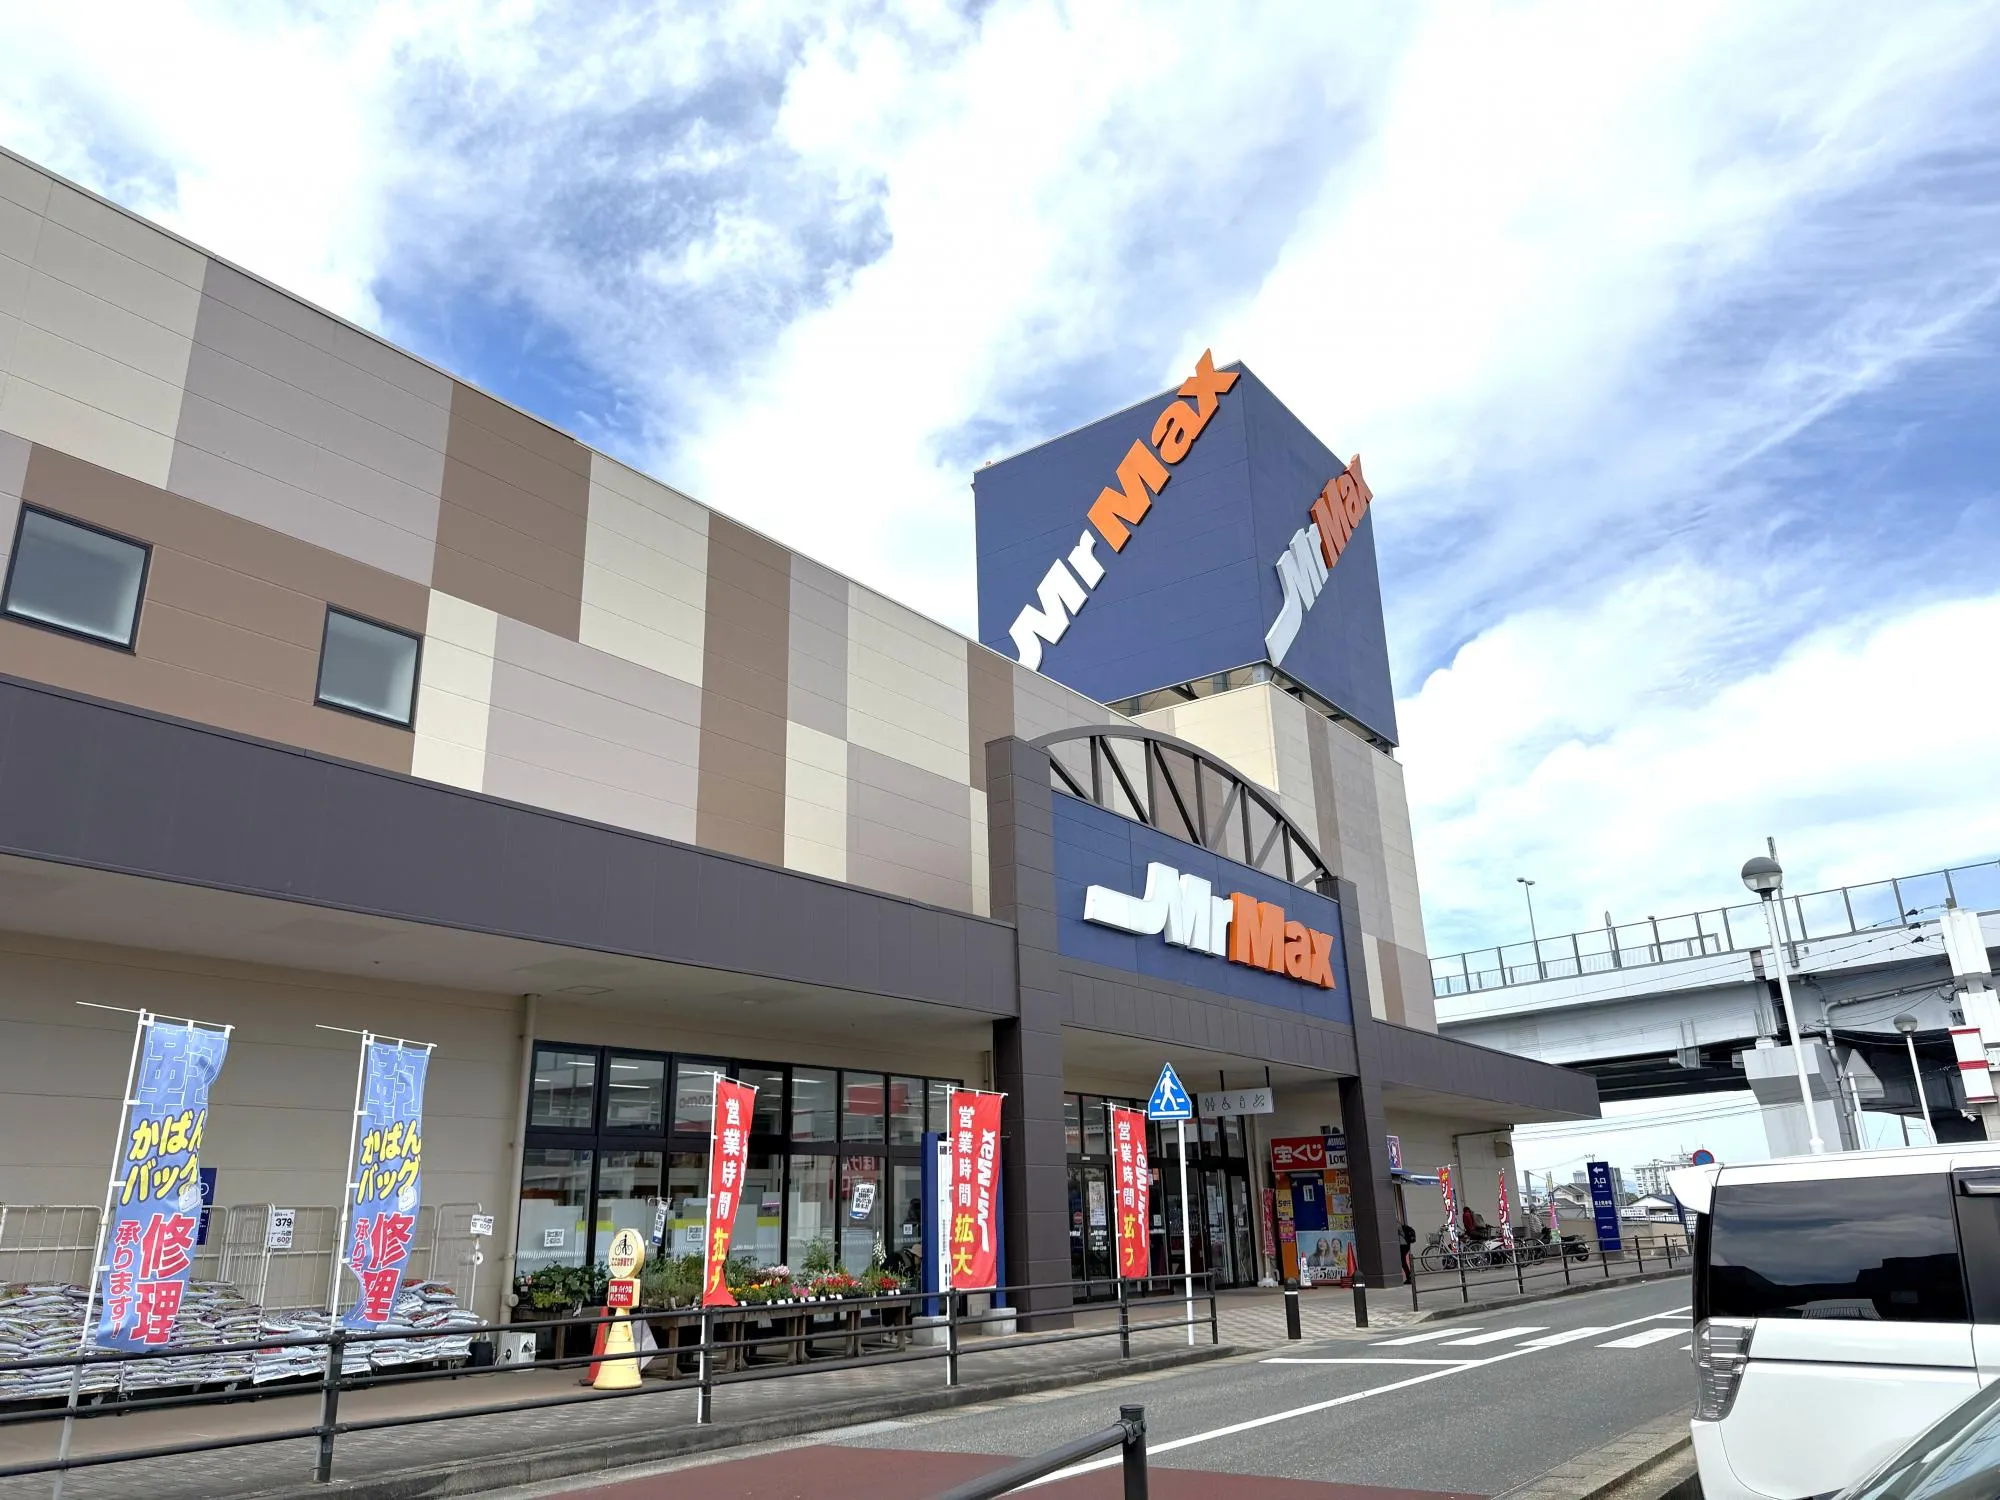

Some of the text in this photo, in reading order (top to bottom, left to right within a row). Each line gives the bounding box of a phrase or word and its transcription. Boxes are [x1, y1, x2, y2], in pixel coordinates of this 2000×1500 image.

[128, 1109, 205, 1160] かばん
[361, 1119, 421, 1165] かばん
[1273, 1143, 1323, 1163] 宝くじ
[356, 1153, 421, 1206] バッグ
[953, 1106, 975, 1276] 営業時間拡大
[275, 1217, 292, 1227] 379
[129, 1212, 197, 1345] 修理
[350, 1211, 415, 1323] 修理
